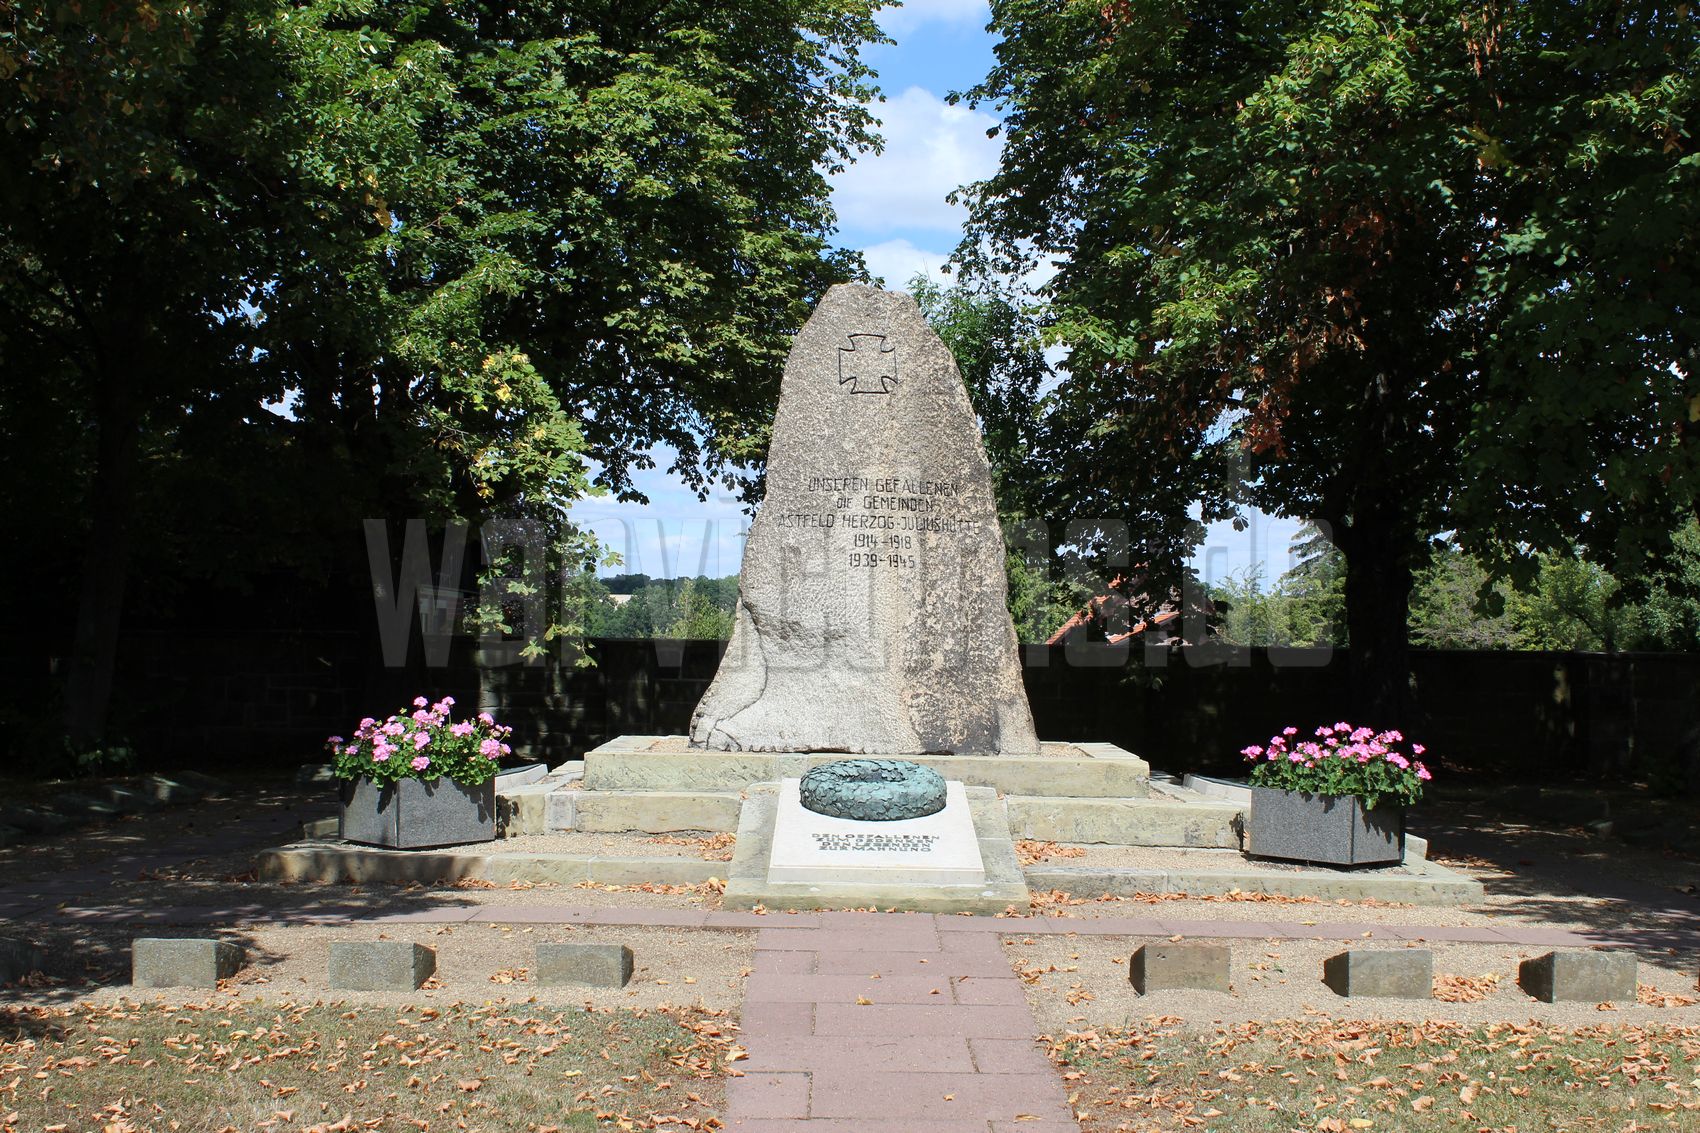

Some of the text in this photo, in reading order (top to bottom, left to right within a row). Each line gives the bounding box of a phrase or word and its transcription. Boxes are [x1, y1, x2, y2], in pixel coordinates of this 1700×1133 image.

[808, 477, 959, 497] UNSEREN GEFALLENEN
[836, 495, 934, 513] DIE GEMEINDEN
[778, 513, 835, 529] ASTFELD
[848, 553, 915, 569] 1939-1945
